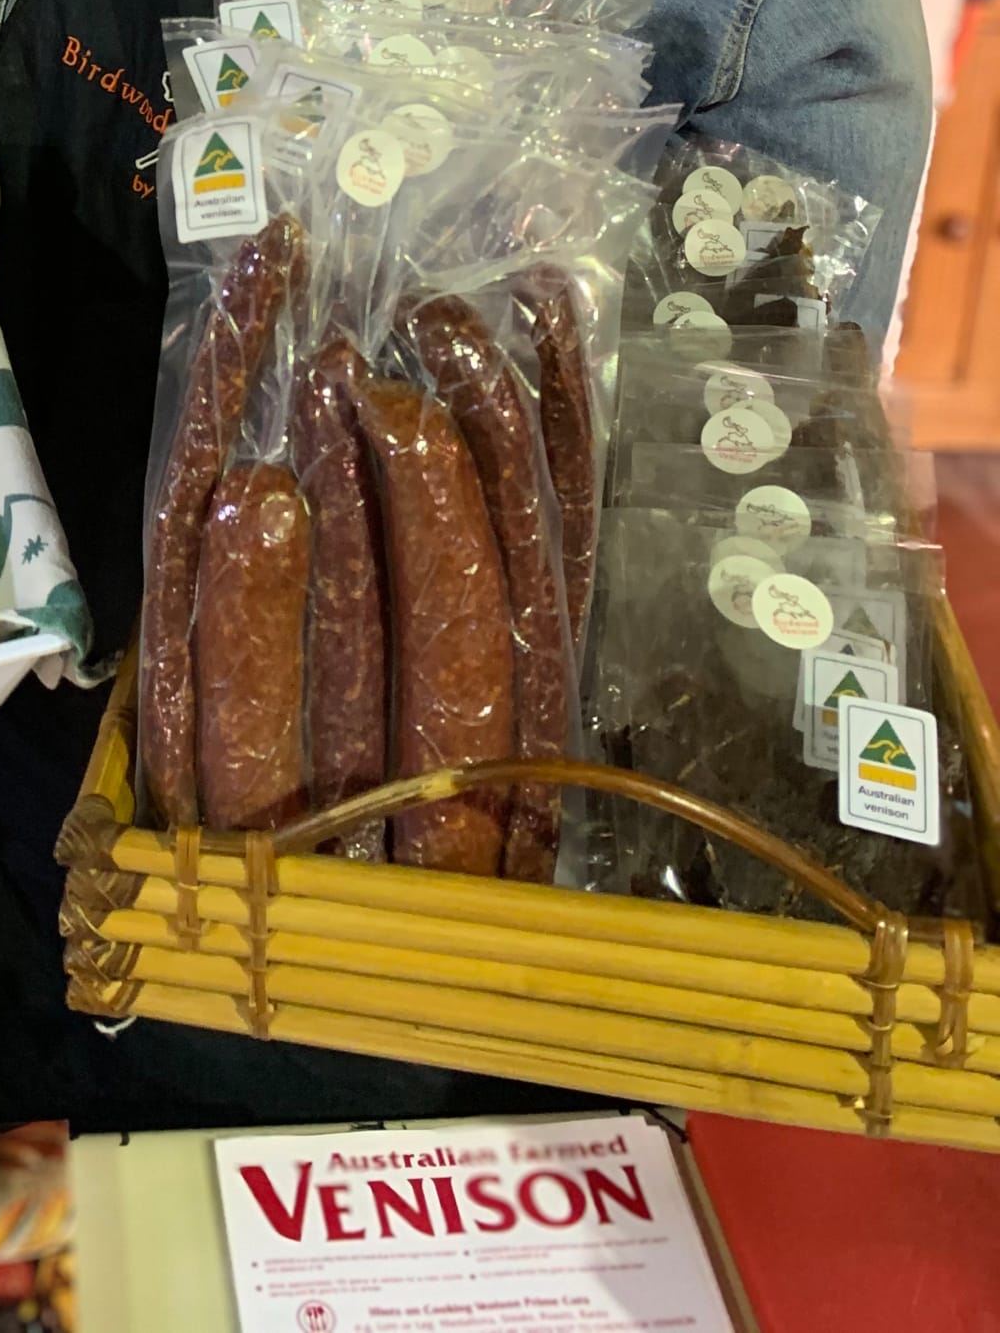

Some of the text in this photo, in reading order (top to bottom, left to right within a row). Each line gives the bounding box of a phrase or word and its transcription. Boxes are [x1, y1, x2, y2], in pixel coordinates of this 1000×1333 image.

[132, 174, 155, 199] by
[194, 195, 246, 207] Australian
[201, 209, 242, 219] venison
[858, 785, 915, 807] Australian
[864, 803, 909, 820] venison
[330, 1144, 497, 1172] Australian
[238, 1160, 654, 1243] VENISON
